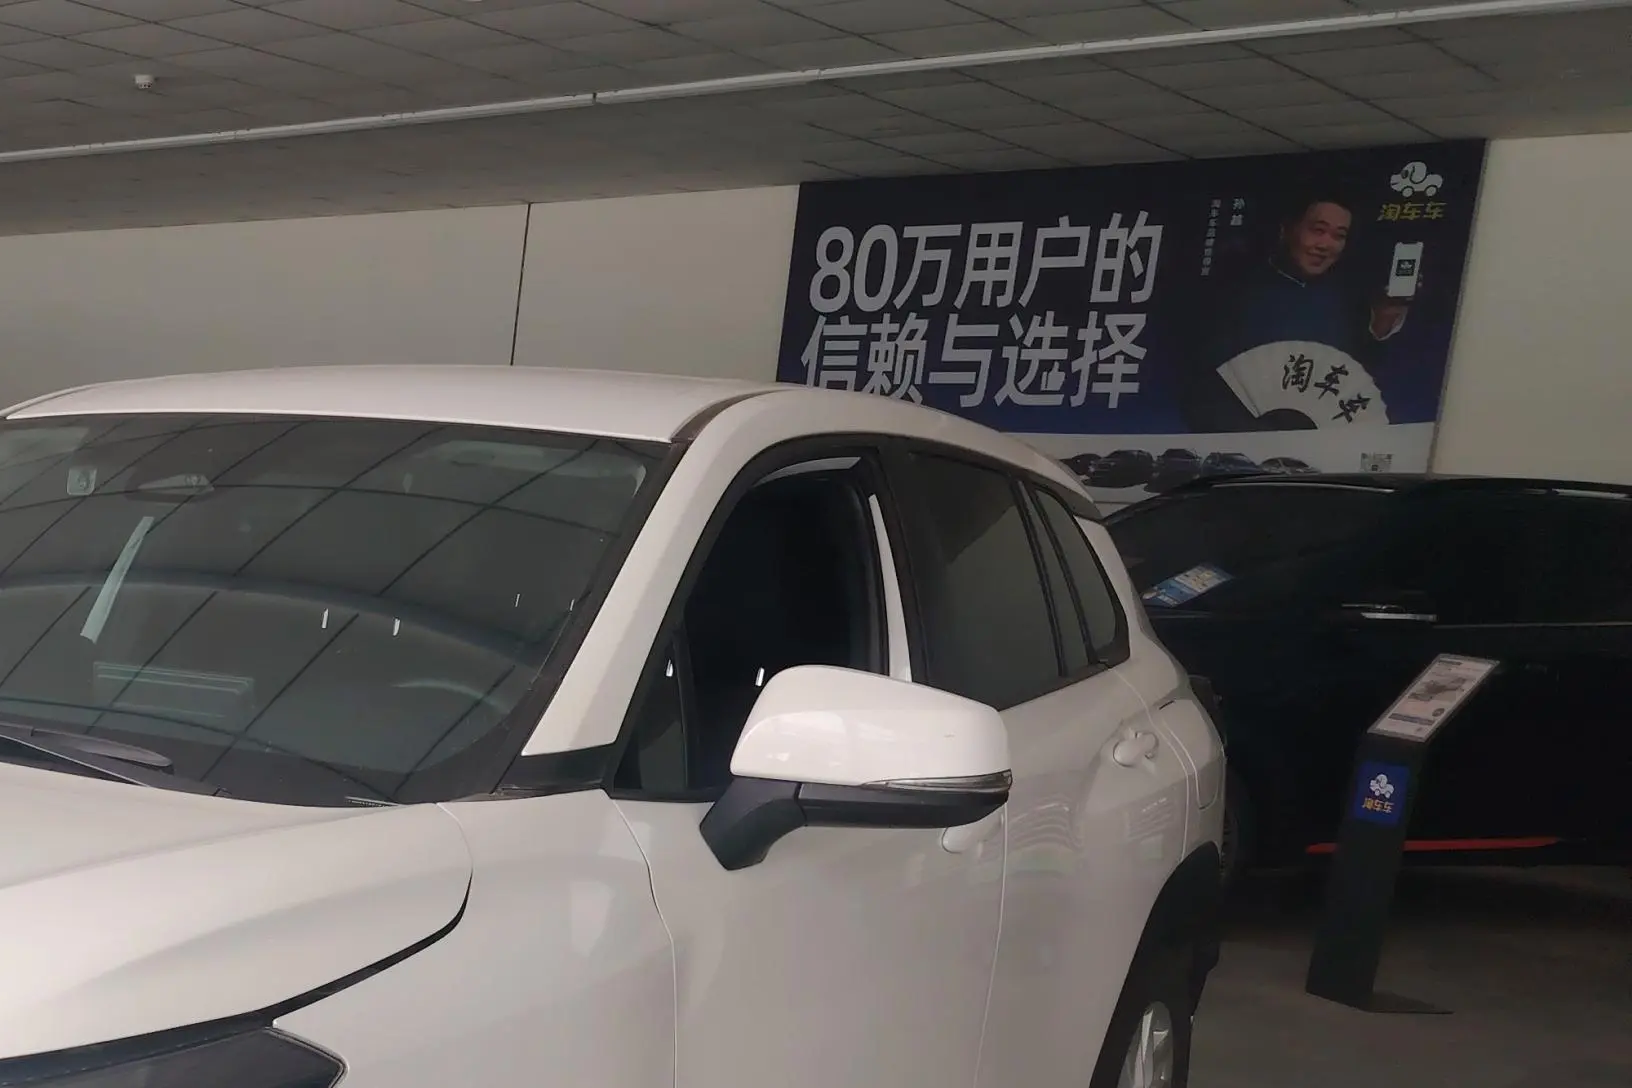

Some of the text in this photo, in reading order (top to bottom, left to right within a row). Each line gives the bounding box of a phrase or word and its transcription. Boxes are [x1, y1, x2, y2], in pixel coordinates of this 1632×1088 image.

[1376, 201, 1447, 222] 淘车车
[809, 210, 1164, 313] 80万用户的
[801, 310, 1148, 409] 信赖与选择
[1282, 353, 1372, 423] 淘车车
